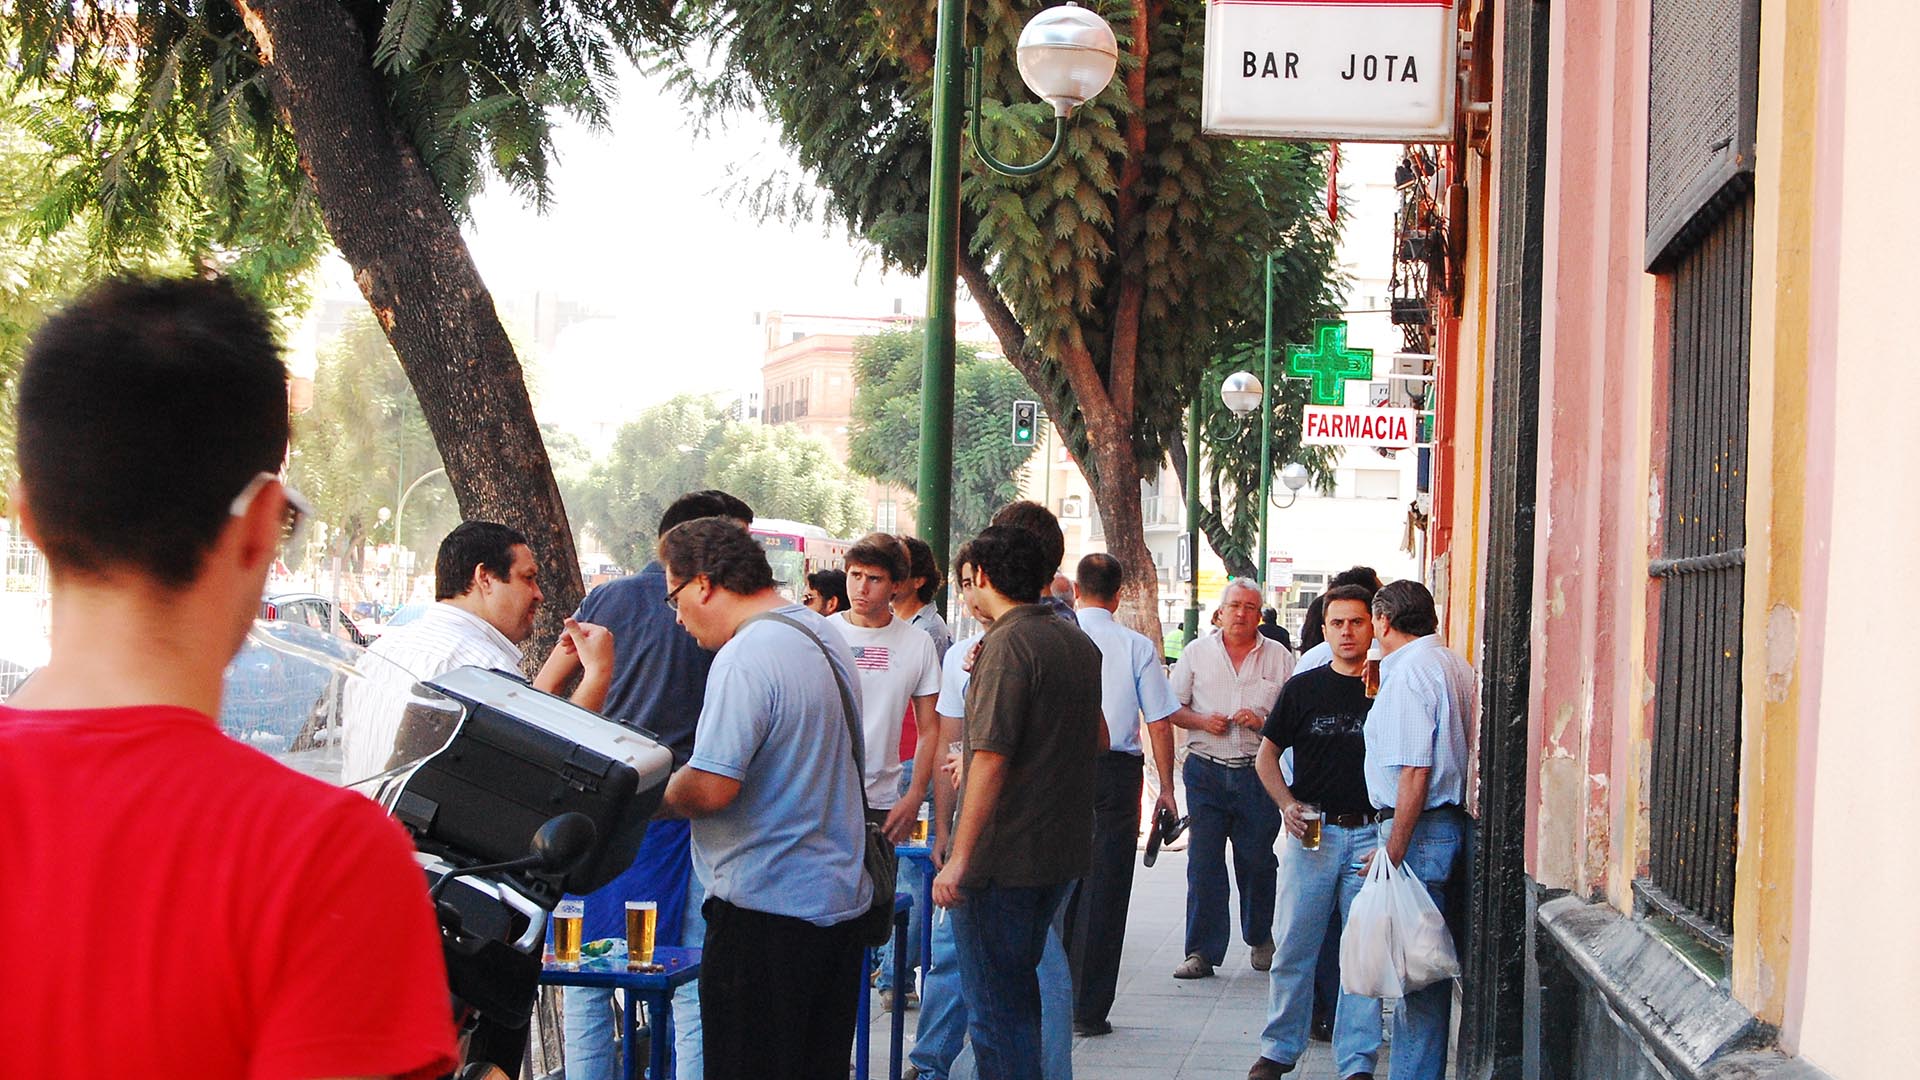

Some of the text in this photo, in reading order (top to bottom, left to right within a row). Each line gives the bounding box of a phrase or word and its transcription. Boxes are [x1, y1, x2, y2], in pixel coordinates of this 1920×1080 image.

[1242, 51, 1418, 82] BAR JOTA
[1307, 413, 1408, 440] FARMACIA
